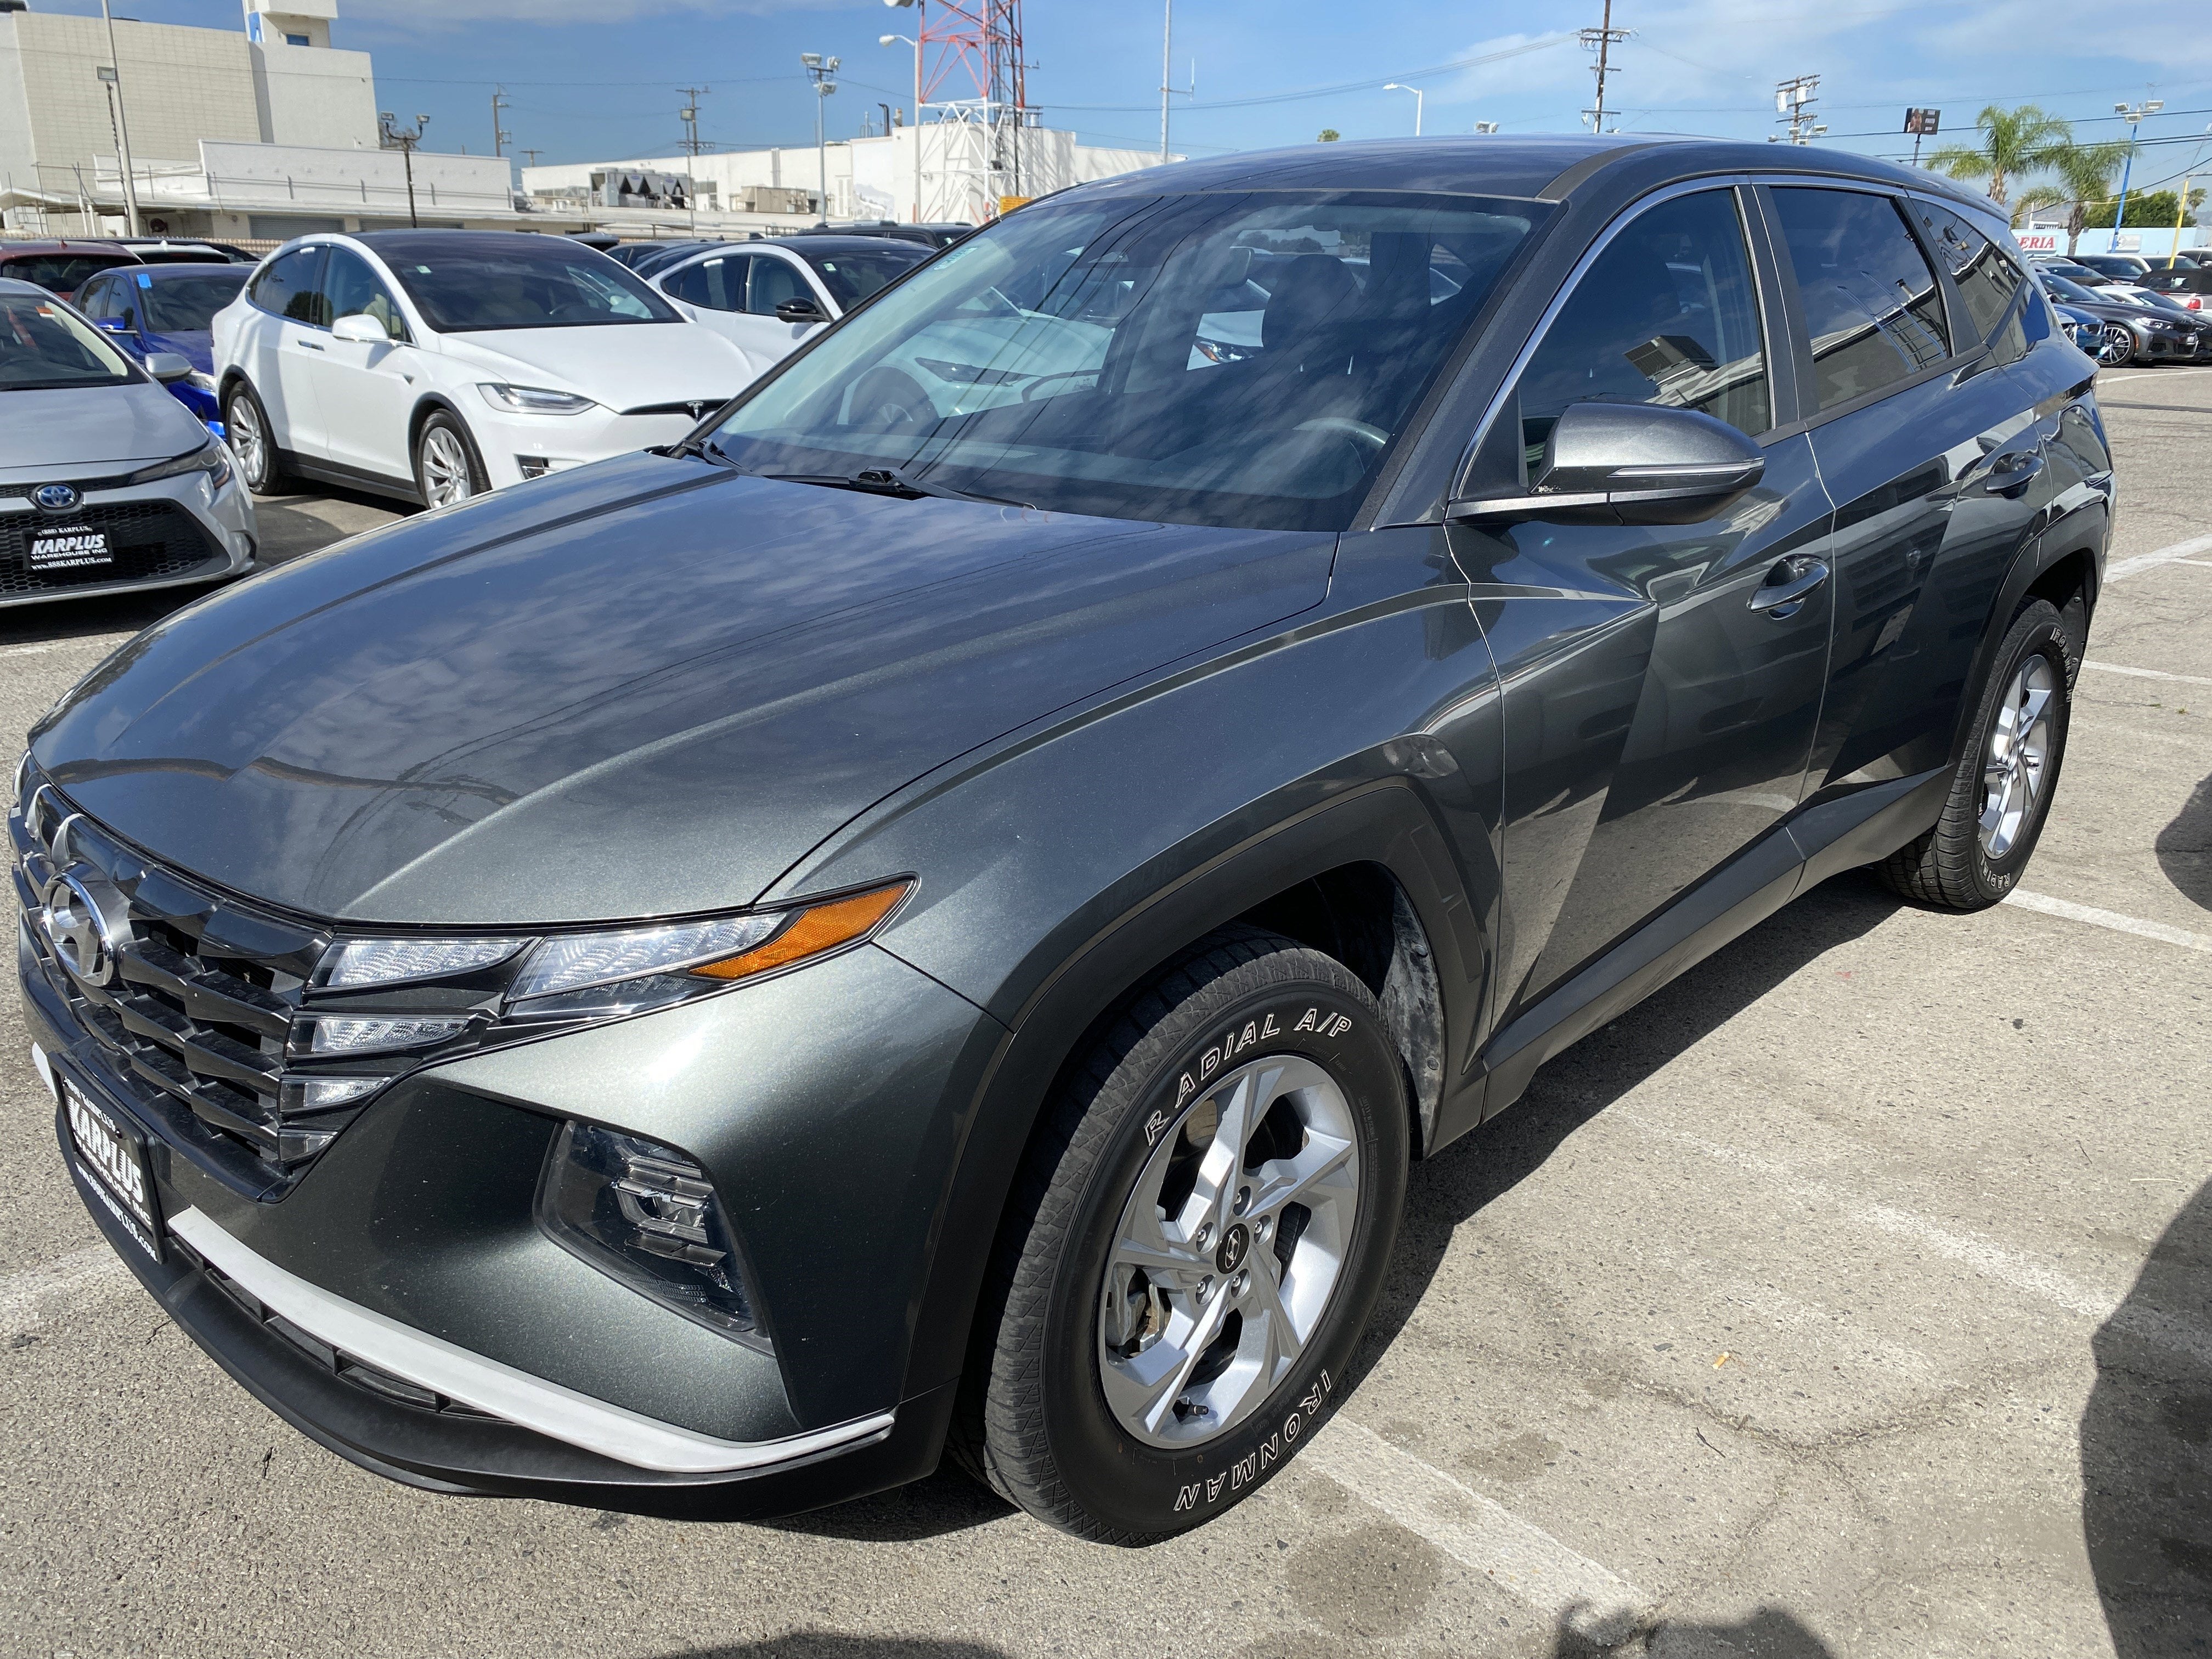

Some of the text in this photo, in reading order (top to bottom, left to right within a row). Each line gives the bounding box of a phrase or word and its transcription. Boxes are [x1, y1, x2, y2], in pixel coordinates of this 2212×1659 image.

[2018, 236, 2054, 249] ERIA
[31, 534, 105, 555] KARPLUS
[31, 550, 90, 561] WAREHOUSE
[58, 526, 88, 534] KARPLUS
[1143, 1013, 1280, 1147] RADIAL
[1293, 1007, 1352, 1037] A/P
[67, 1094, 143, 1203] KARPLUS
[73, 1131, 151, 1226] WAREHOUSE INC
[1173, 1368, 1331, 1511] IRONMAN
